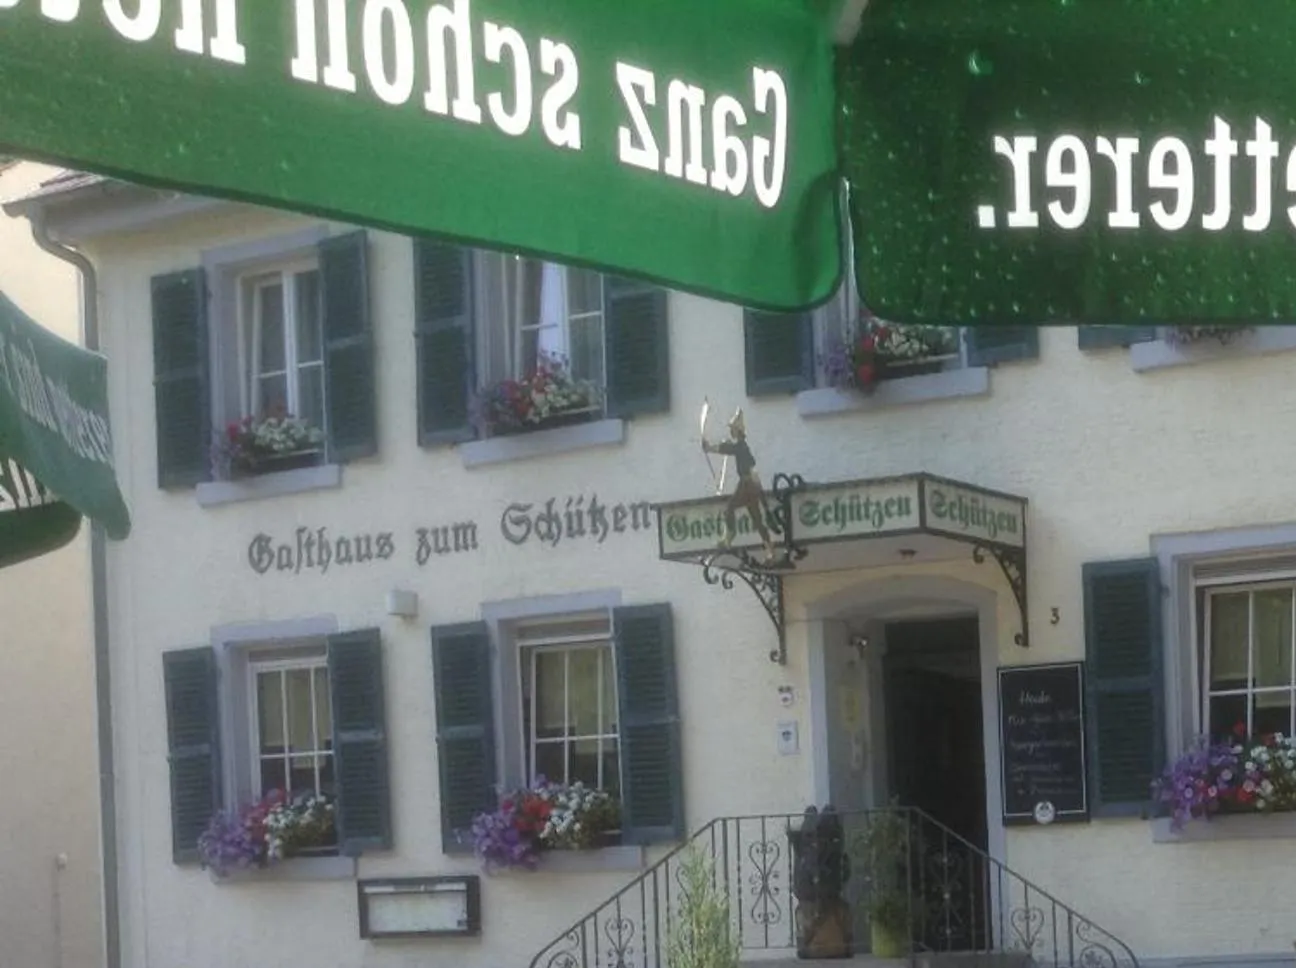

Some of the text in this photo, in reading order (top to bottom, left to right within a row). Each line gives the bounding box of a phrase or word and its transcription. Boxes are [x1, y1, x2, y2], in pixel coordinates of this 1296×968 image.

[799, 493, 912, 531] Schützen
[930, 490, 1017, 538] Schützen
[415, 521, 478, 566] zum
